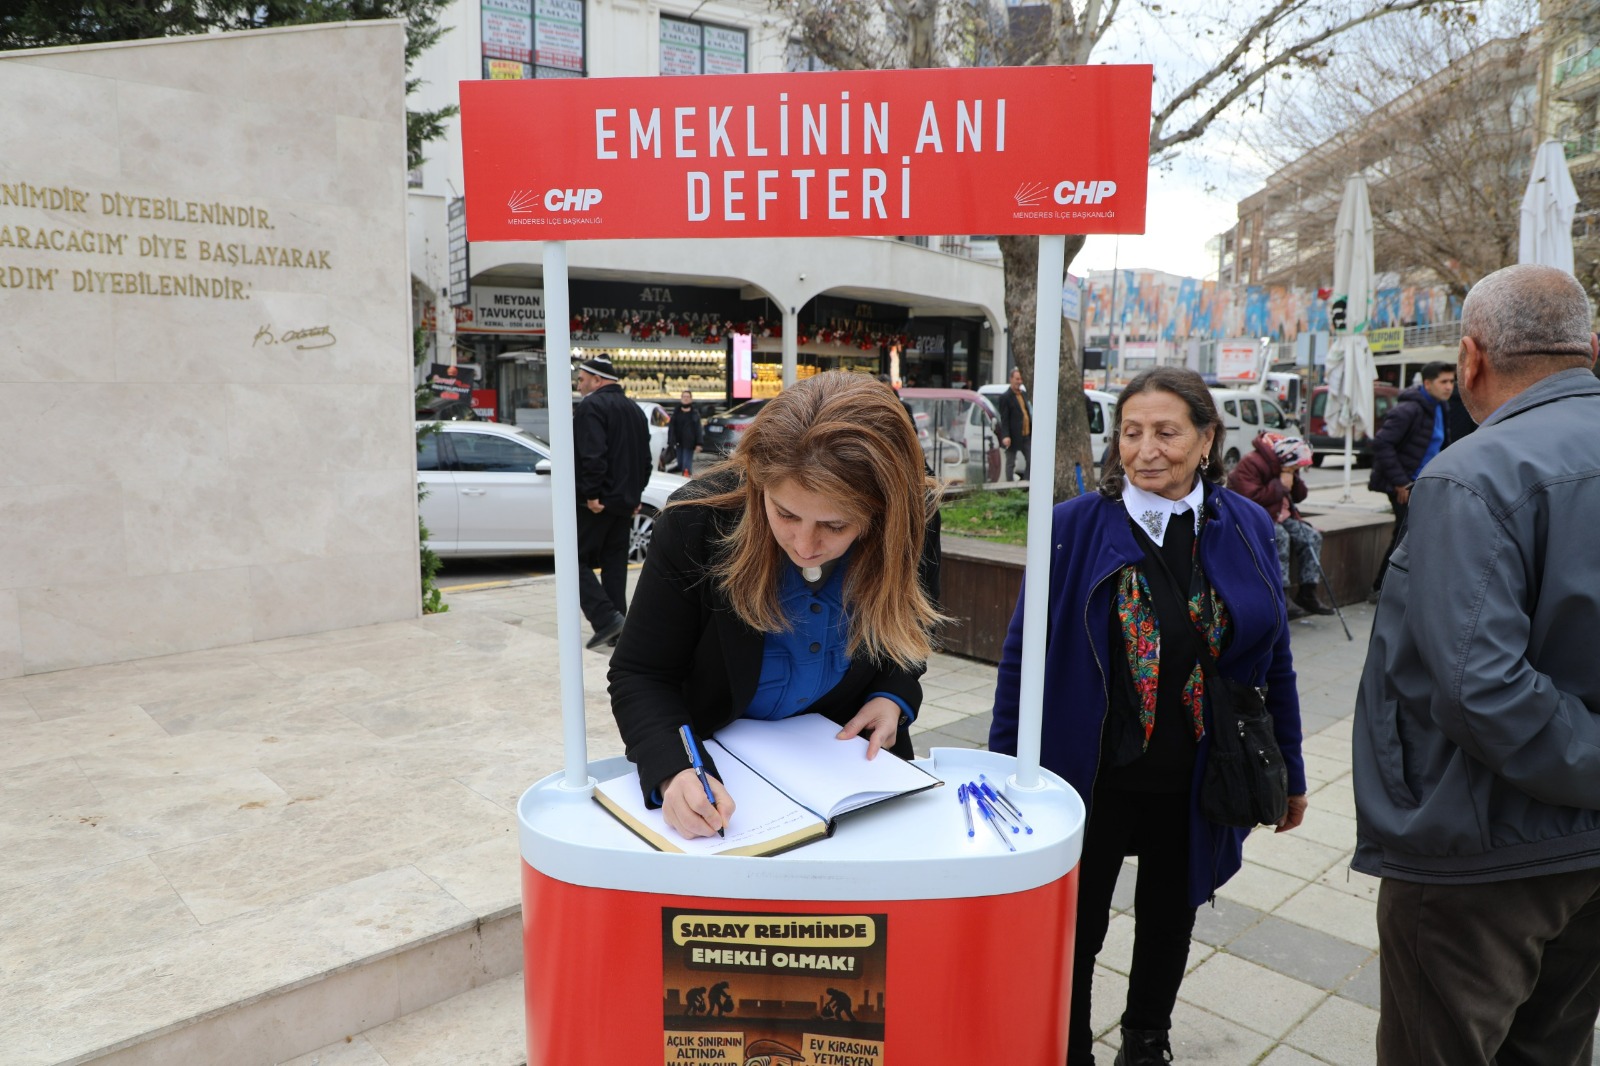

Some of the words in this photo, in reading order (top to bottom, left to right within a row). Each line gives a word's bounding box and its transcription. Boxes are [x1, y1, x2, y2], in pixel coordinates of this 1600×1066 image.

[595, 91, 889, 160] EMEKLİNİN
[915, 98, 1006, 154] ANI
[687, 155, 911, 222] DEFTERİ
[1053, 180, 1117, 205] CHP
[0, 181, 90, 213] NİMDİR'
[100, 190, 276, 230] DİYEBİLENİNDİR.
[544, 188, 603, 212] CHP
[546, 217, 561, 226] İLÇE
[563, 216, 603, 226] BAŞKANLIĞI
[1013, 211, 1053, 219] MENDERES
[1054, 210, 1070, 219] İLÇE
[1072, 209, 1115, 219] BAŞKANLIĞI
[139, 233, 187, 260] DİYE
[199, 241, 332, 270] BAŞLAYARAK
[494, 294, 540, 306] MEYDAN
[640, 287, 672, 302] ATA
[681, 922, 750, 938] SARAY
[755, 921, 867, 939] REJİMİNDE
[692, 947, 767, 966] EMEKLİ
[772, 953, 855, 971] OLMAK!
[667, 1036, 694, 1048] AÇLIK
[698, 1036, 742, 1048] SINIRININ
[810, 1038, 824, 1050] EV
[828, 1041, 879, 1056] KİRASINA
[677, 1048, 726, 1059] ALTINDA
[813, 1052, 873, 1066] YETMEYEN
